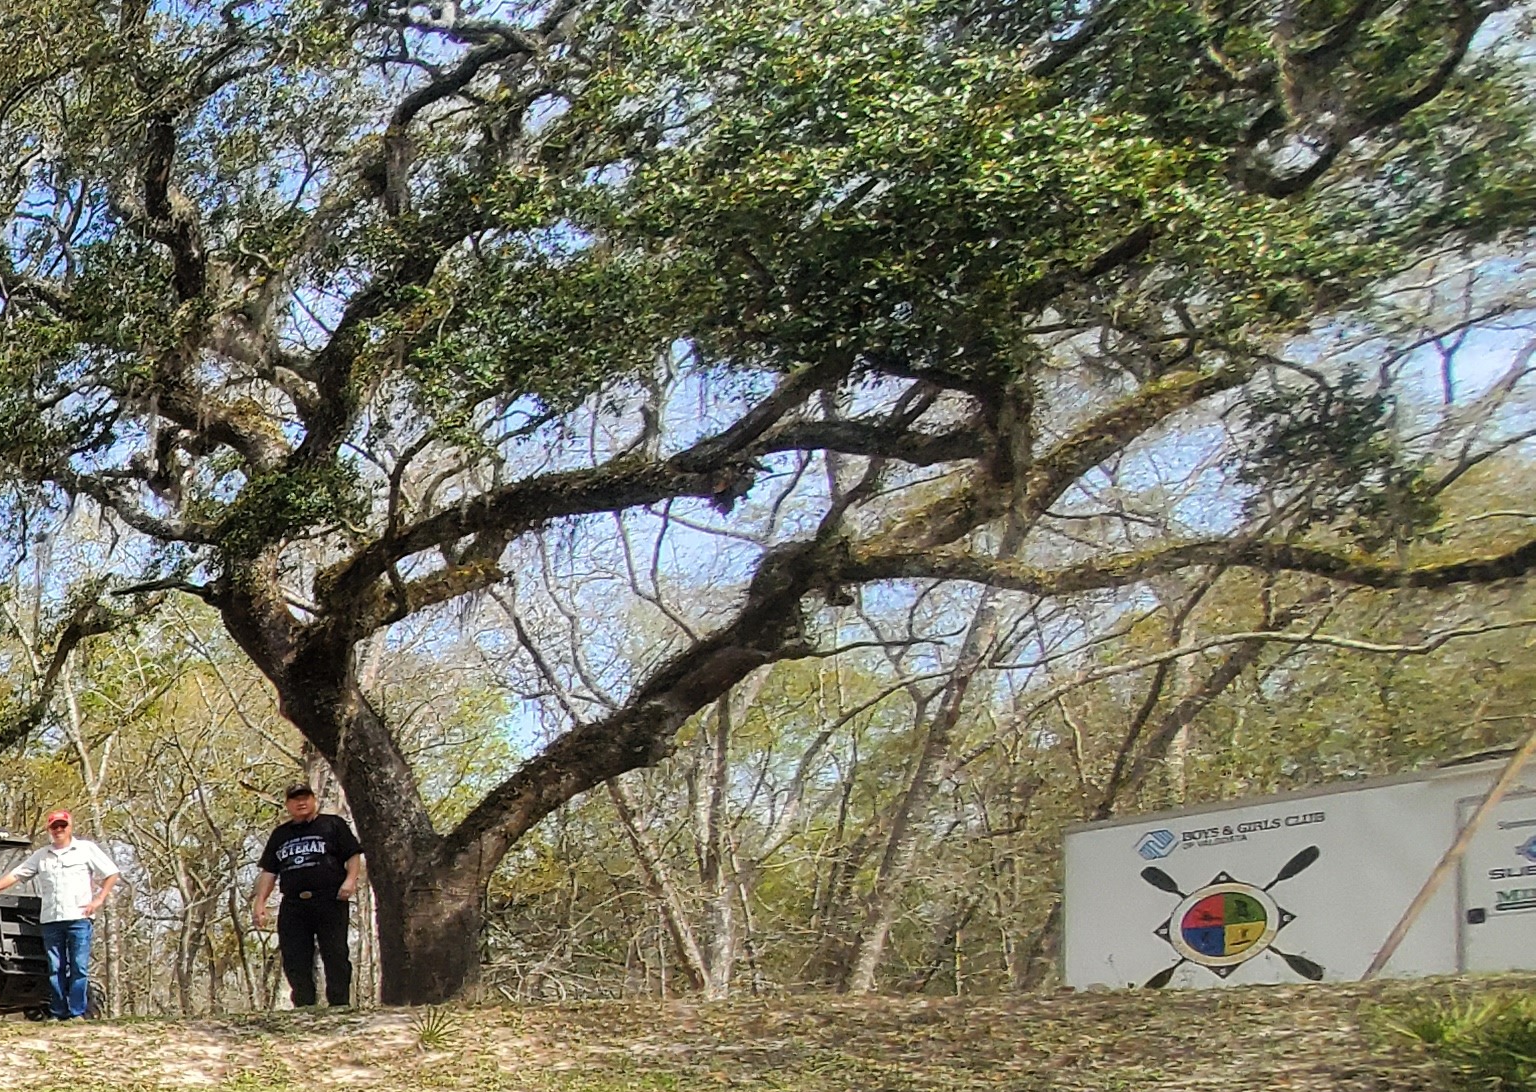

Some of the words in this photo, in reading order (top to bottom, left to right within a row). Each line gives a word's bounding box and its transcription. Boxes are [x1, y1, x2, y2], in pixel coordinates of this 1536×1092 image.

[1182, 827, 1219, 842] BOYS
[1223, 825, 1234, 836] &
[1238, 818, 1281, 833] GIRLS
[1285, 812, 1325, 826] CLUB
[275, 840, 326, 861] VETERAN
